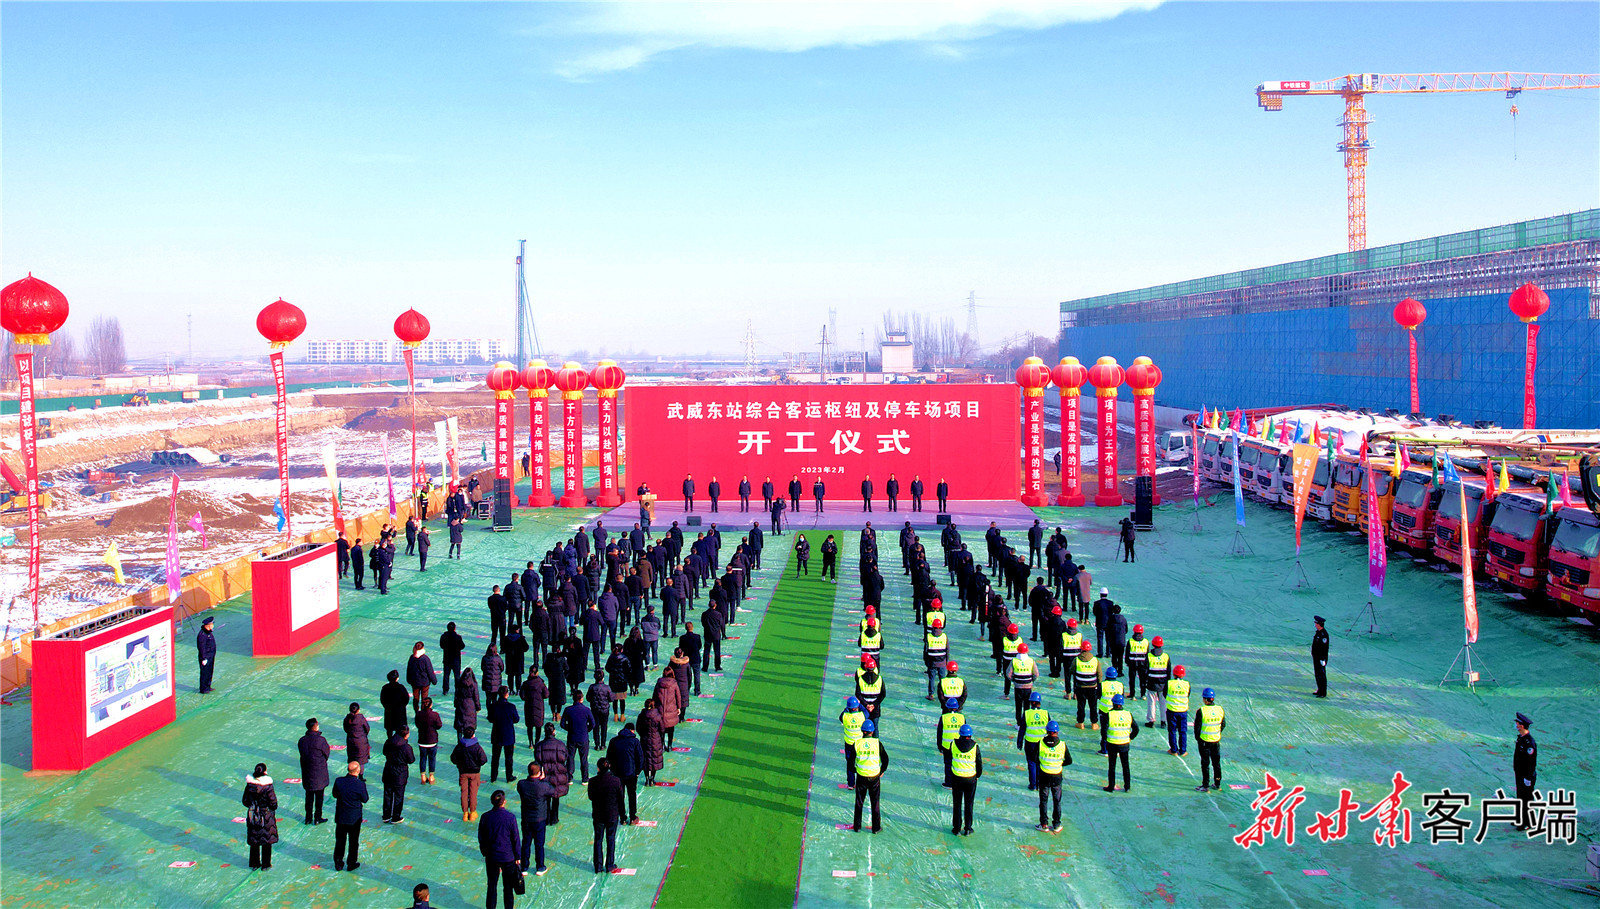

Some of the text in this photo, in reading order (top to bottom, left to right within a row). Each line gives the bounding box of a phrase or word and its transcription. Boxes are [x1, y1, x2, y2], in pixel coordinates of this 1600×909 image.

[498, 402, 508, 478] 高质量建设项
[534, 401, 544, 490] 高起点推动项目
[566, 402, 576, 491] 千方百计引投资
[602, 400, 613, 489] 全力以赴抓项目
[667, 400, 981, 420] 武威东站综合客运枢纽及停车场项目
[738, 429, 911, 455] 开工仪式
[1030, 400, 1040, 491] 产业是发展的基石
[1067, 398, 1077, 489] 项目是发展的引擎
[1104, 399, 1114, 489] 项目为王不动摇
[1139, 398, 1150, 477] 高质量发展不松
[800, 466, 846, 474] 2023年2月
